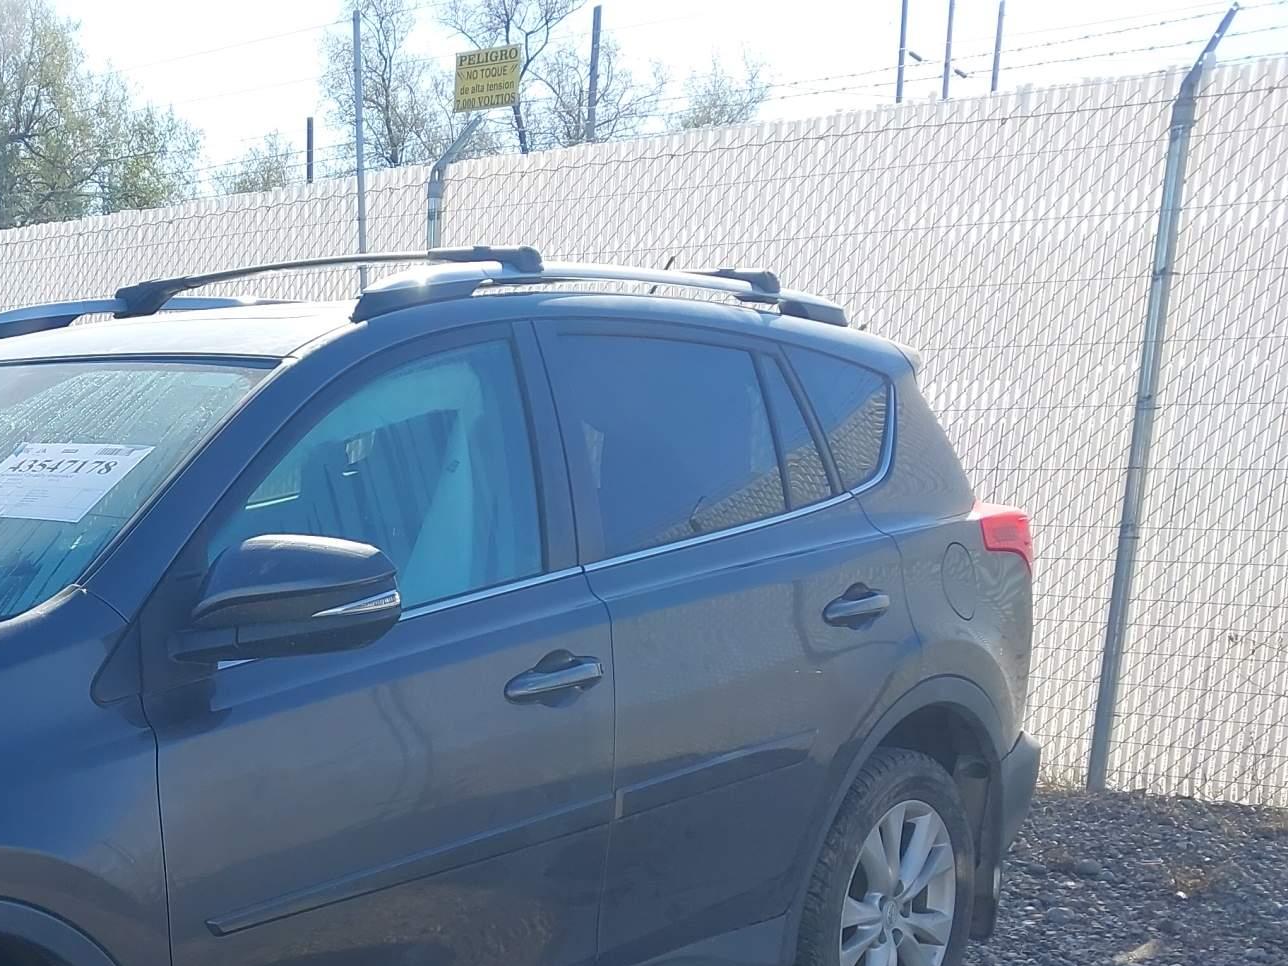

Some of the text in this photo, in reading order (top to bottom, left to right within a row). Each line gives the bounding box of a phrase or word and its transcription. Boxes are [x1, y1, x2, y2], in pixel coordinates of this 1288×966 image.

[459, 48, 518, 66] PELIGRO
[466, 65, 508, 80] NO TOQUE
[460, 85, 470, 95] de
[471, 83, 485, 94] alta
[478, 92, 516, 107] VOLTIOS
[8, 459, 118, 475] 43547178
